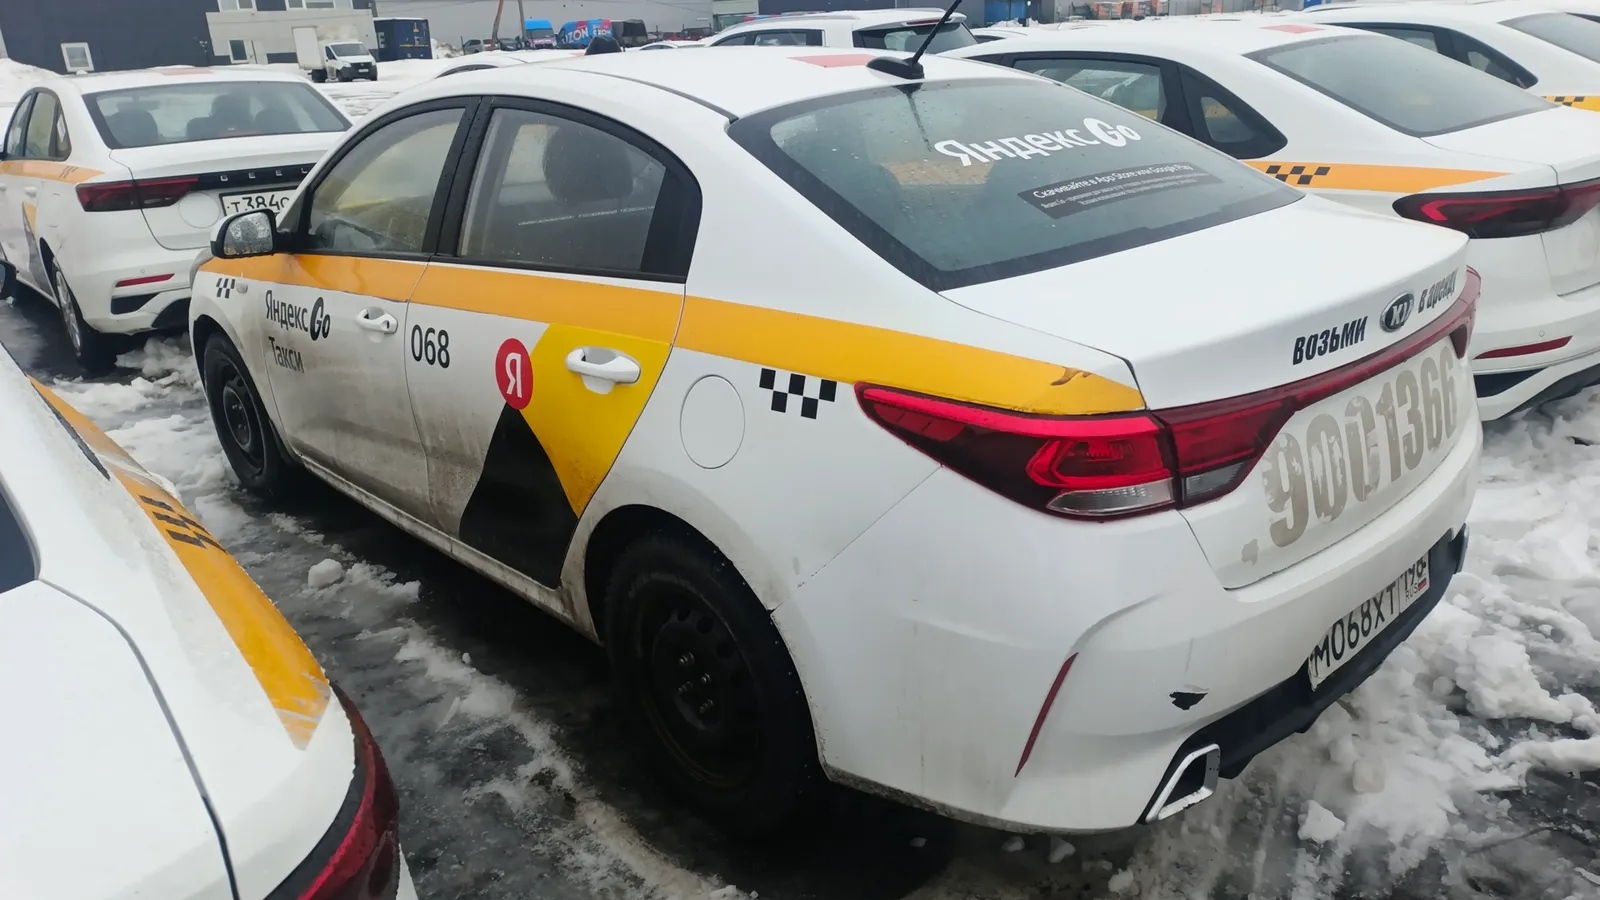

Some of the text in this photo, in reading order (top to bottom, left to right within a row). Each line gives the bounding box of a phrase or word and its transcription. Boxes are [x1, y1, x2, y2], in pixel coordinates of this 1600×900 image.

[1033, 181, 1092, 199] Скачивайте
[1095, 175, 1116, 184] App
[1112, 170, 1138, 180] Store
[1148, 165, 1176, 173] Google
[268, 336, 305, 374] Такси
[410, 323, 451, 369] 068
[505, 352, 523, 399] Я
